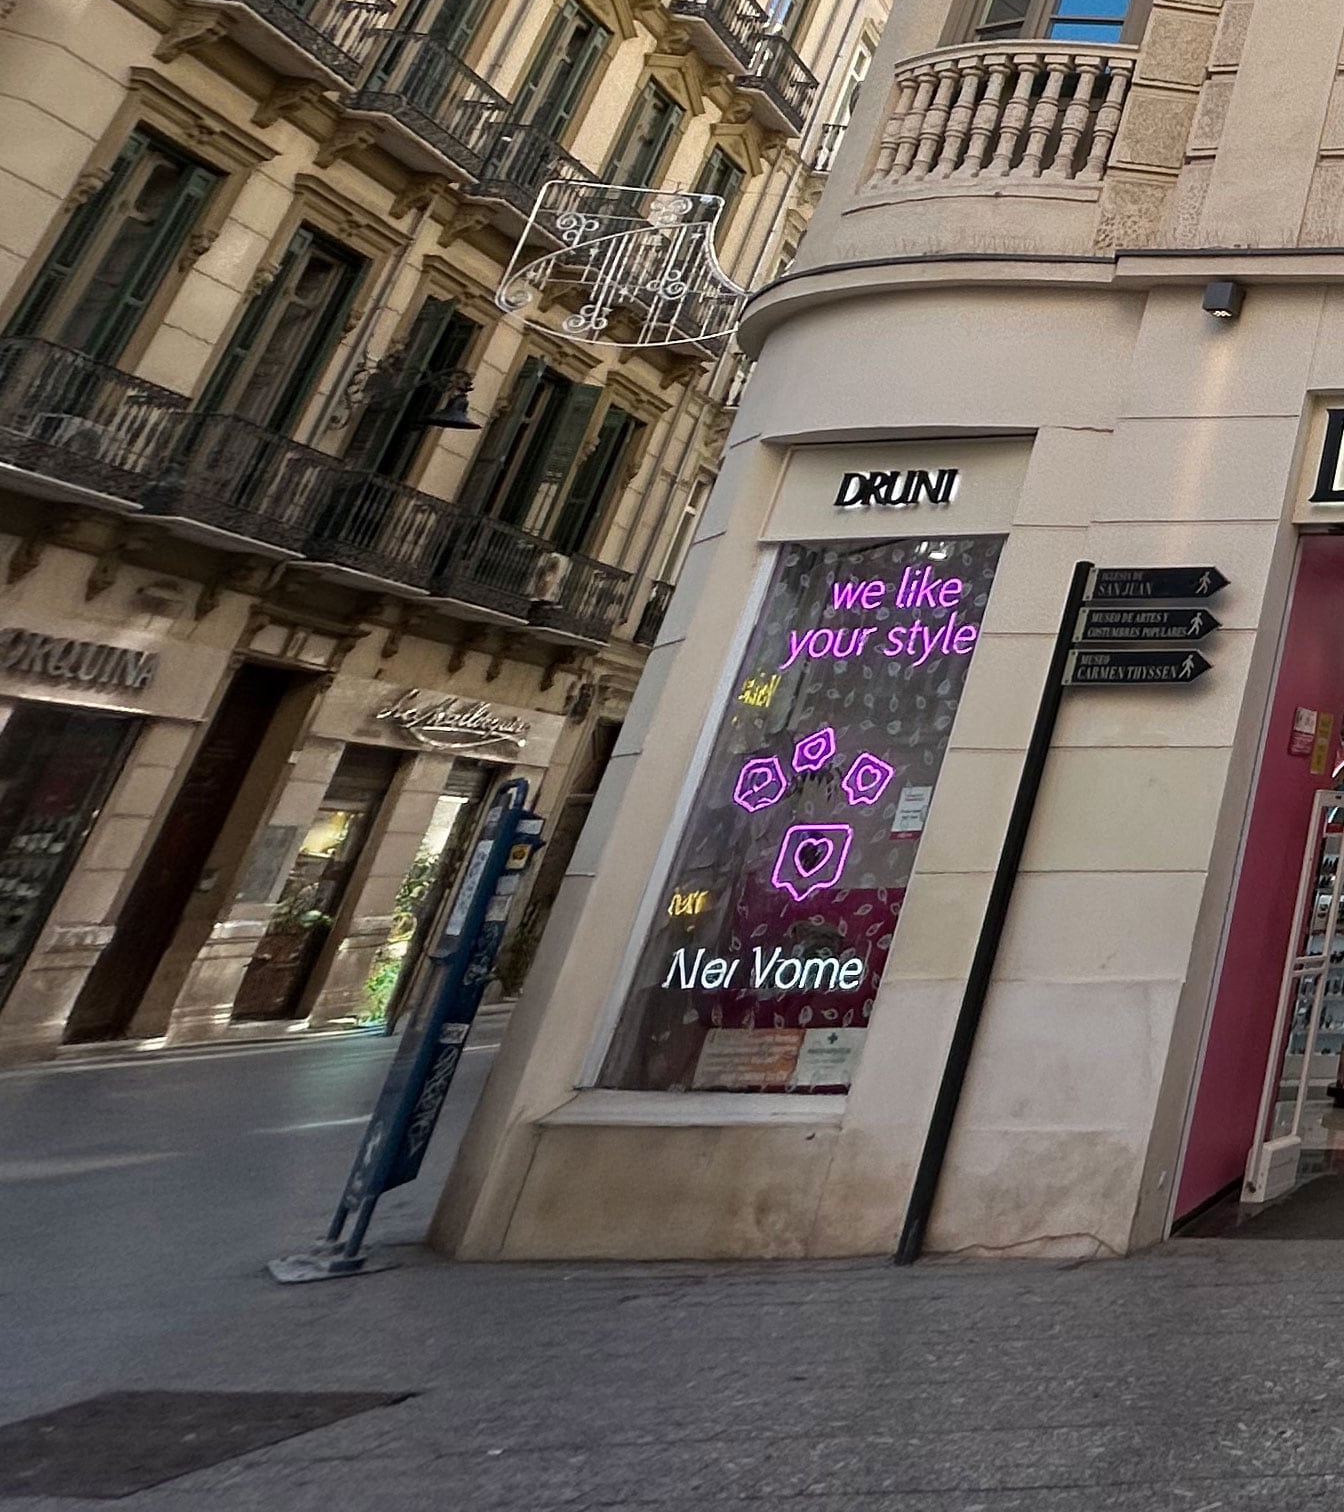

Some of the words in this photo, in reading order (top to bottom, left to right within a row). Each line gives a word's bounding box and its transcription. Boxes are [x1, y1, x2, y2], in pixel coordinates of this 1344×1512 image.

[833, 468, 959, 506] DRUNI
[833, 580, 886, 610] we
[895, 565, 963, 609] like
[1098, 582, 1120, 597] SAN
[1121, 582, 1152, 597] JUAN
[1091, 612, 1120, 623] MUSEO
[1121, 612, 1132, 623] DE
[1135, 612, 1161, 623] ARTES
[1162, 612, 1169, 623] Y
[1087, 627, 1140, 638] COSTUMBRES
[1142, 626, 1187, 638] POPULARES
[779, 625, 878, 671] your
[883, 610, 977, 668] style
[1080, 654, 1111, 665] MUSEO
[1077, 666, 1125, 680] CARMEN
[1126, 666, 1177, 680] THYSSEN
